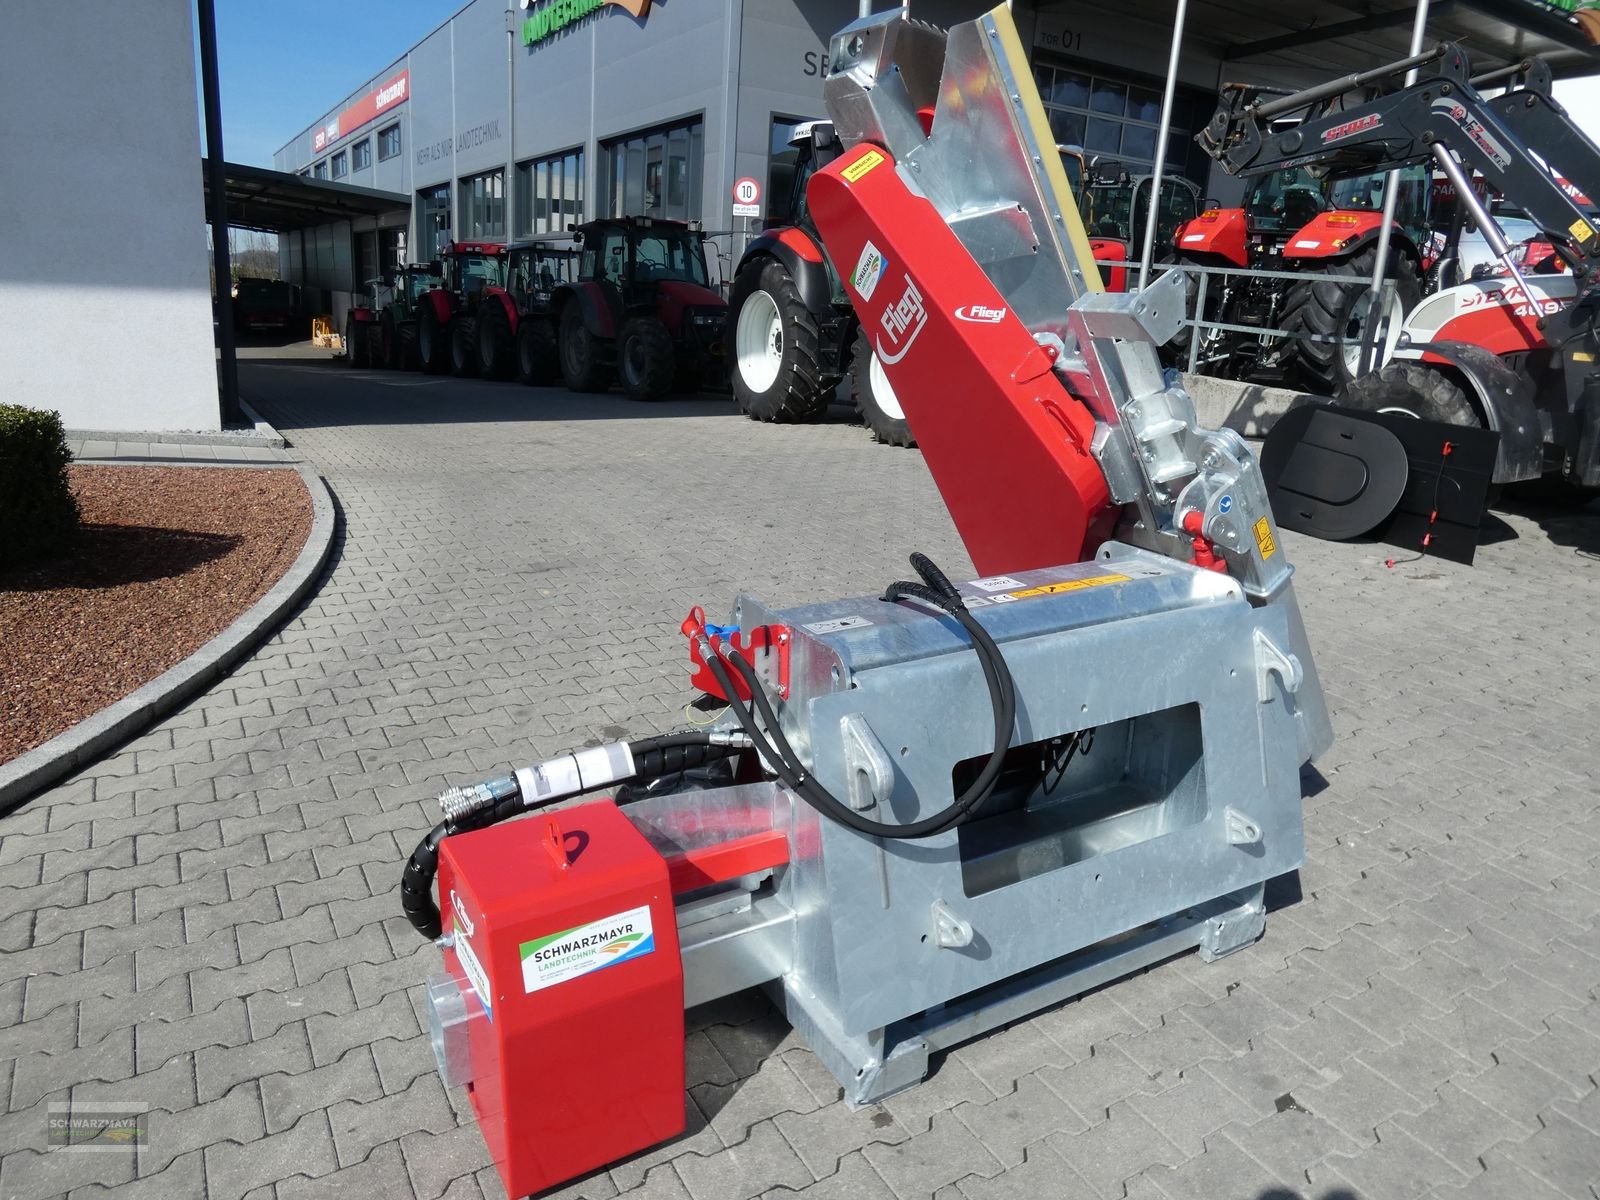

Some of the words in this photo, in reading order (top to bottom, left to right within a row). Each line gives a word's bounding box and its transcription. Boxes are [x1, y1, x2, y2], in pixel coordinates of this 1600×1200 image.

[1041, 32, 1058, 46] TOR
[1062, 29, 1081, 51] 01
[1325, 114, 1379, 142] STOLL
[848, 155, 873, 174] VORSICHT
[742, 185, 752, 199] 10
[1461, 285, 1526, 309] STEYR
[880, 273, 925, 345] Fliegl
[970, 305, 1007, 322] Fliegl
[1514, 301, 1564, 317] 409
[534, 923, 634, 963] SCHWARZMAYR
[538, 948, 597, 972] LANDTECHNIK
